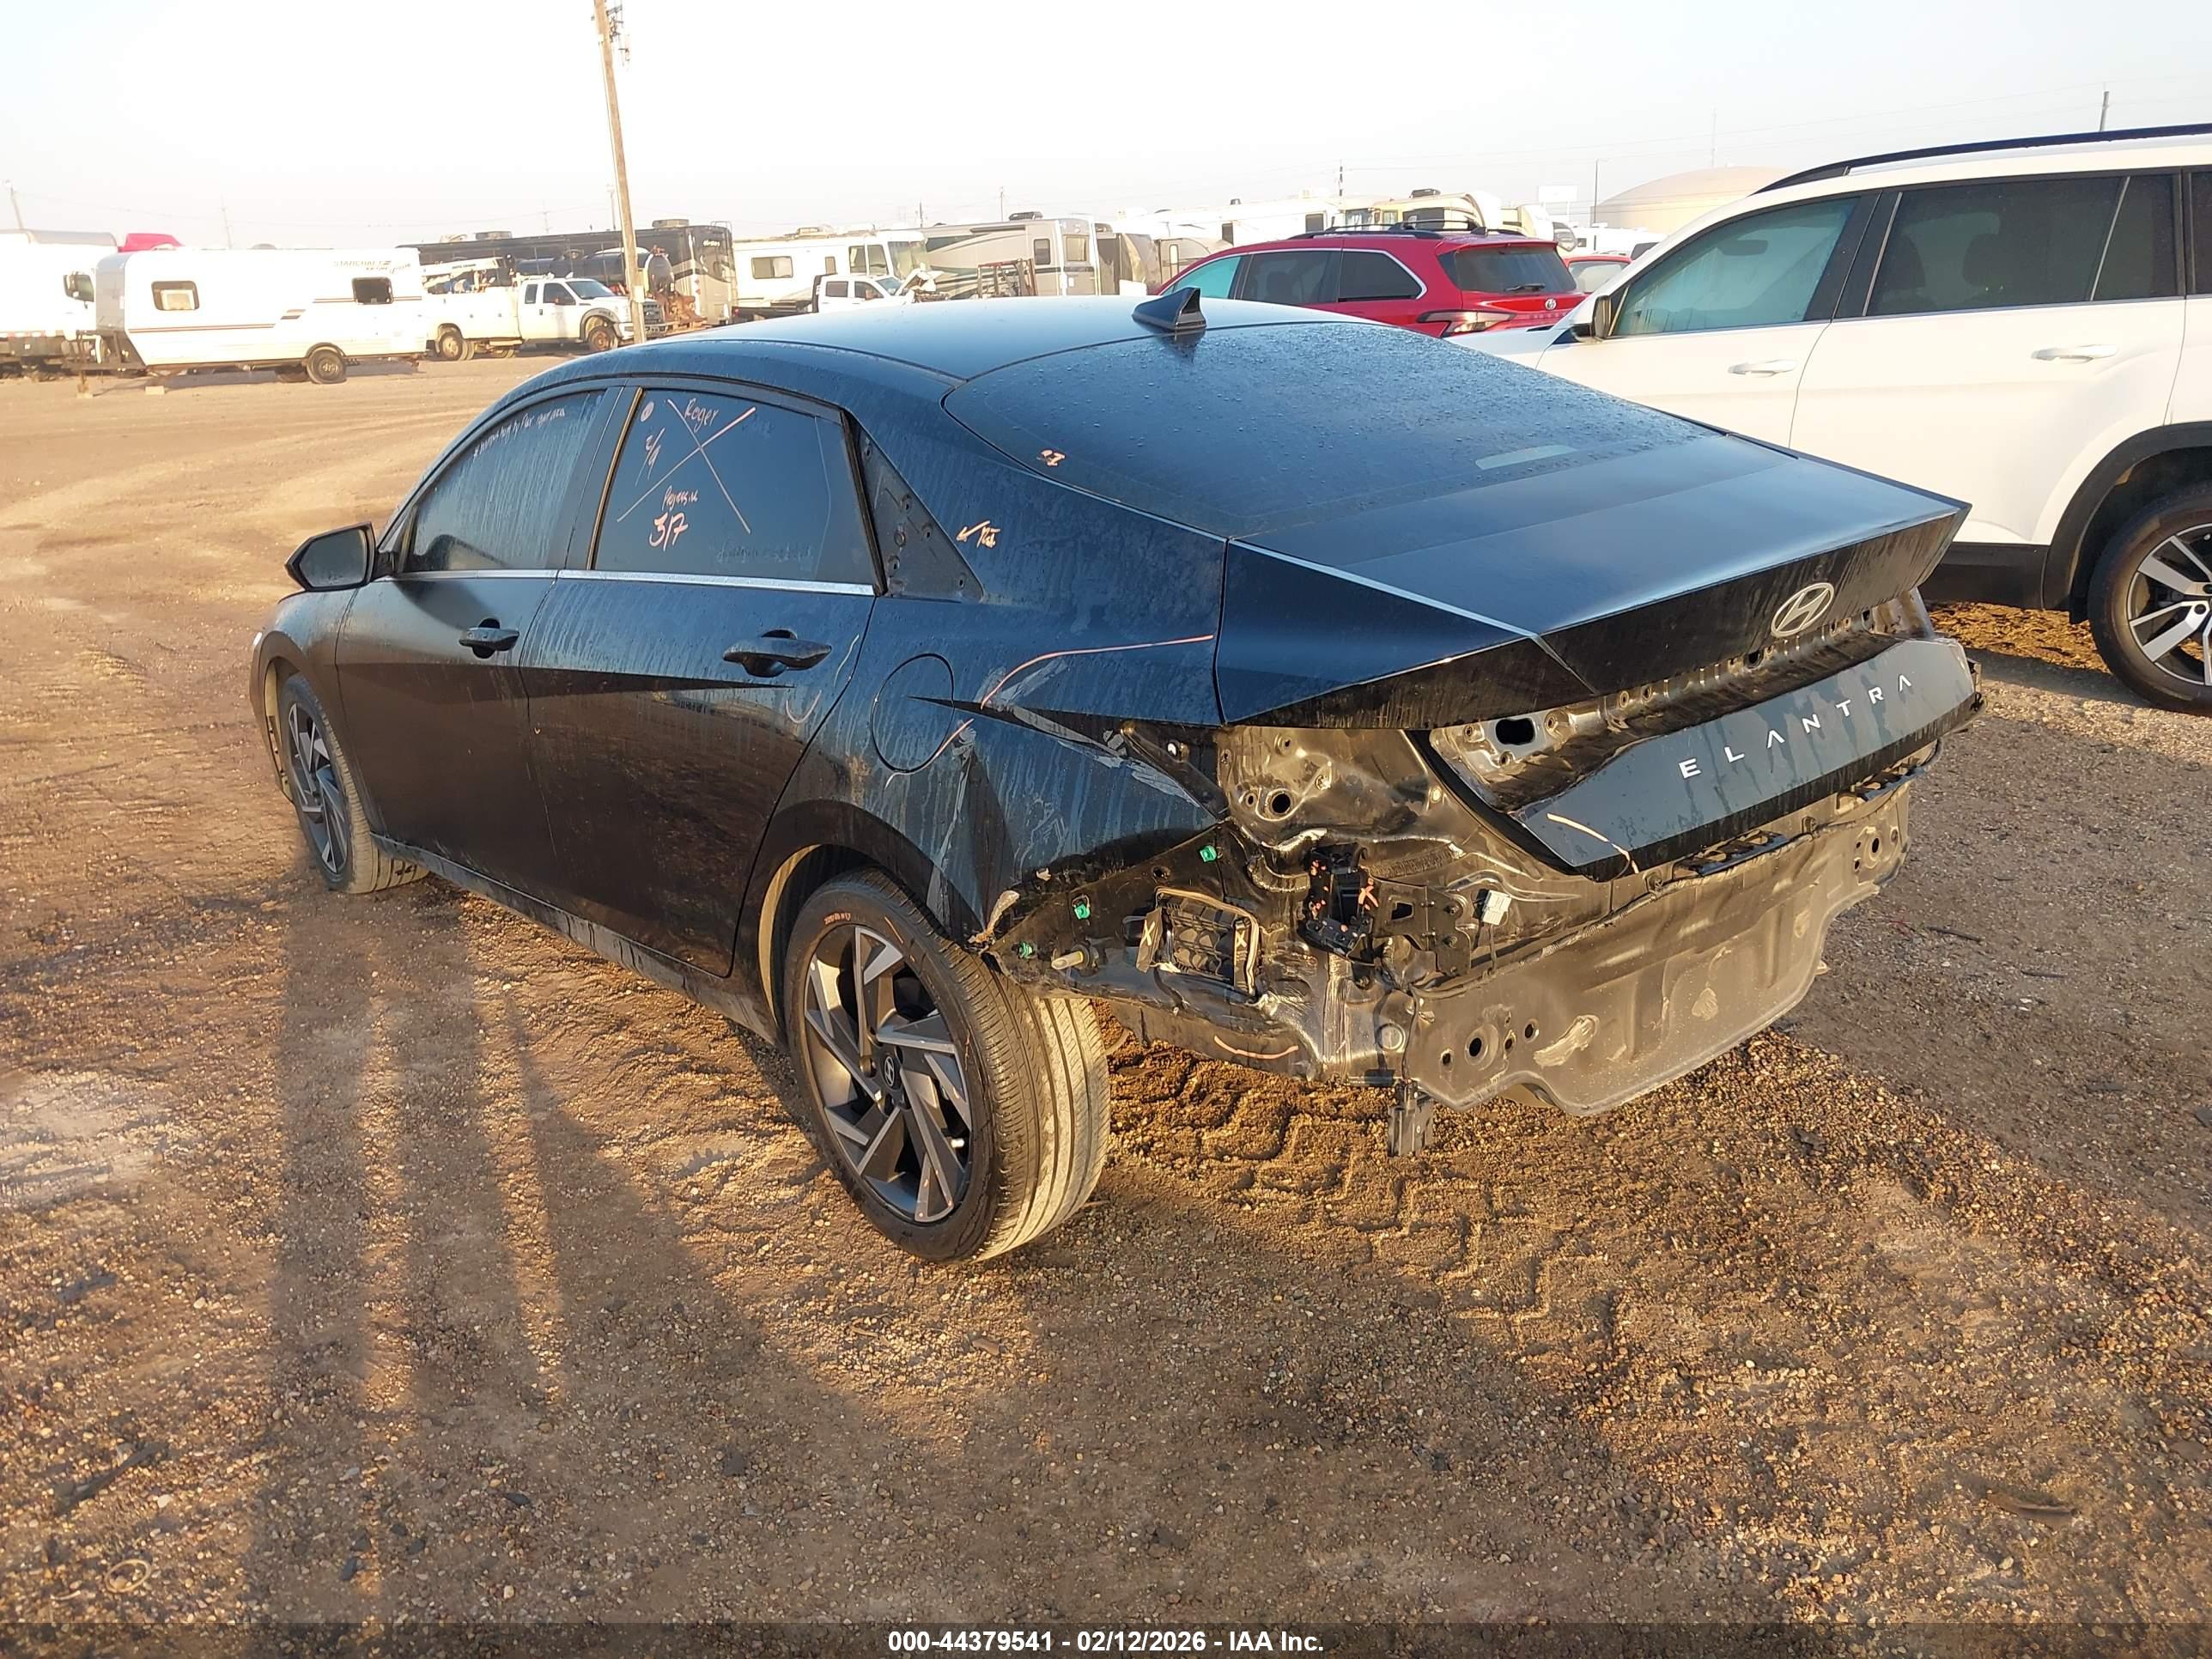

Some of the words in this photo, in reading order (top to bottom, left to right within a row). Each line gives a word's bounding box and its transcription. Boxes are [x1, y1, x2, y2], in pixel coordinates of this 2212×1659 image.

[684, 398, 719, 433] Roger
[648, 512, 689, 552] 3/7
[1678, 674, 1911, 779] ELANTRA
